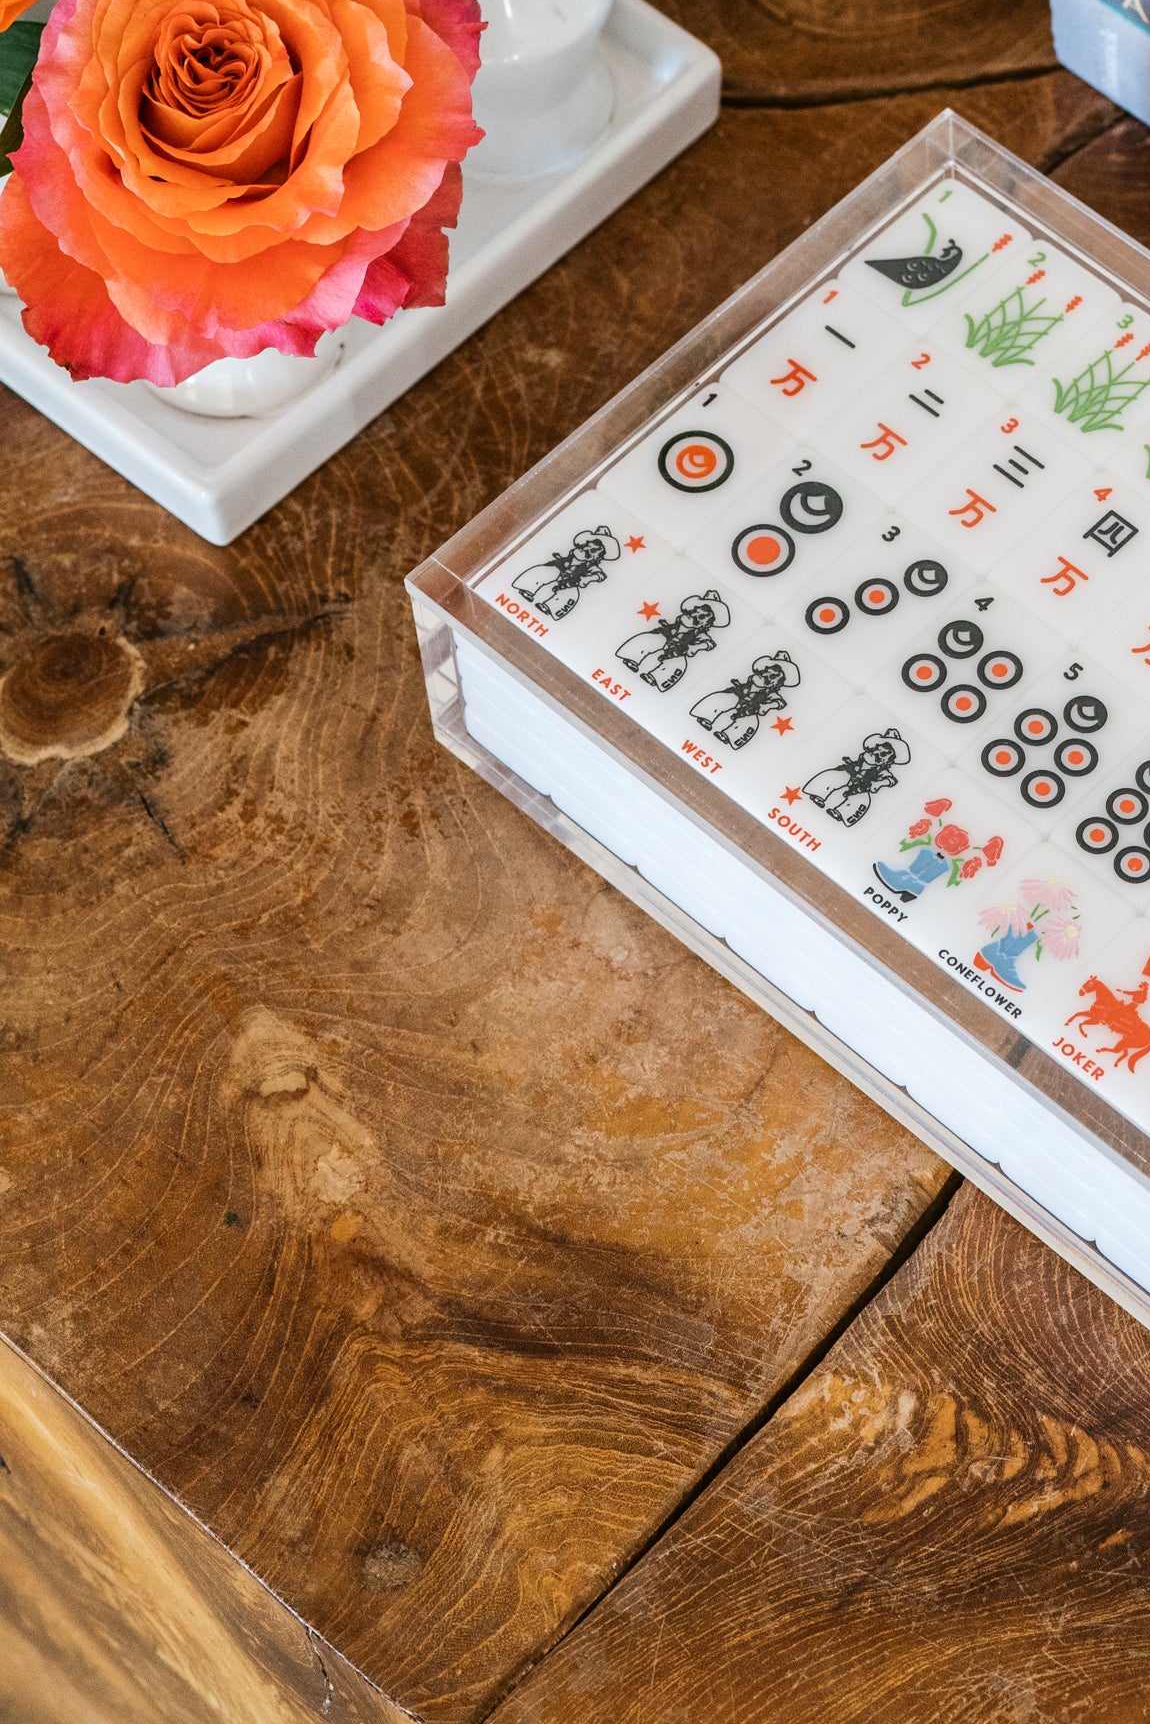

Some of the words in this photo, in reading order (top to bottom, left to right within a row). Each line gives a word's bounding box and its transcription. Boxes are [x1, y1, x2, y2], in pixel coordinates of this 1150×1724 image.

[939, 190, 953, 203] 1
[1027, 251, 1047, 268] 2
[822, 290, 839, 305] 1
[1116, 314, 1134, 330] 3
[910, 352, 931, 371] 2
[701, 393, 718, 408] 1
[1000, 417, 1020, 435] 3
[791, 459, 813, 477] 2
[1093, 487, 1113, 502] 4
[881, 525, 901, 543] 3
[973, 596, 995, 612] 4
[494, 592, 550, 638] NORTH
[1062, 662, 1084, 681] 5
[591, 668, 632, 702] EAST
[681, 738, 724, 775] WEST
[767, 807, 822, 853] SOUTH
[863, 885, 910, 924] POPPY
[937, 948, 1023, 1020] CONEFLOWER
[1052, 1036, 1106, 1082] JOKER
